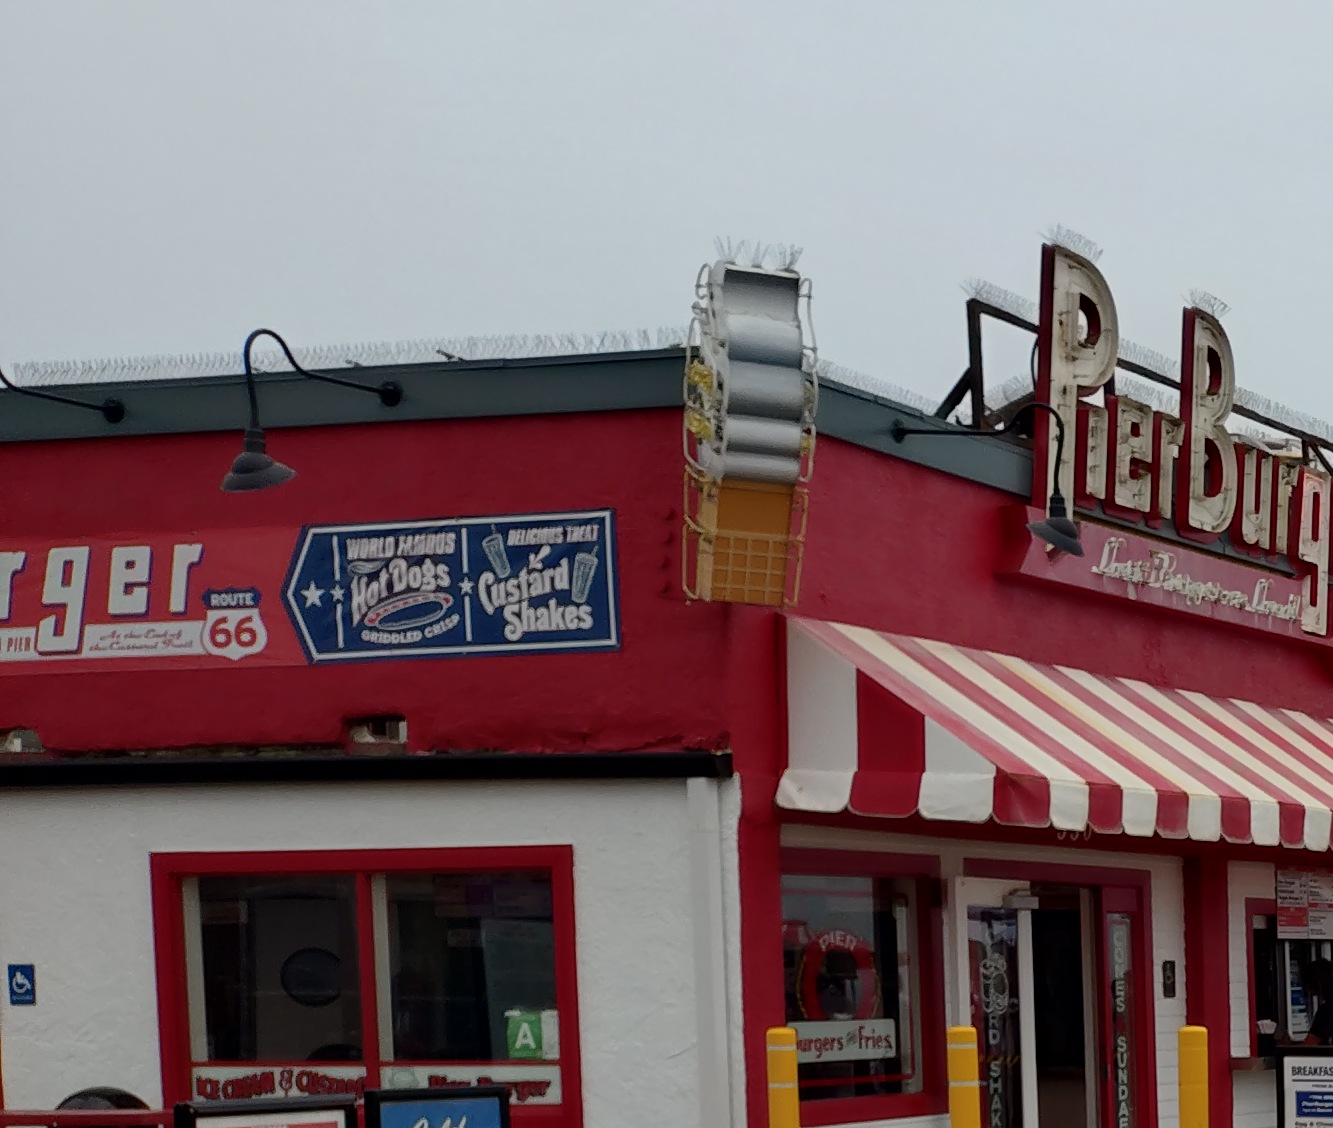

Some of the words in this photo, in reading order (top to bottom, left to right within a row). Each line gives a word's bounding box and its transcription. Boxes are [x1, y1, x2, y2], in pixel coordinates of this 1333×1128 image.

[345, 535, 395, 560] WORLD
[396, 531, 456, 557] FAMOUS
[507, 526, 564, 547] DELICIOUS
[566, 524, 600, 543] TREAT
[210, 592, 254, 606] ROUTE
[350, 566, 390, 628] Hot
[388, 557, 451, 593] Dogs
[478, 556, 570, 616] Custard
[209, 615, 257, 648] 66
[361, 629, 423, 645] GRIDDLED
[424, 613, 461, 639] CRISP
[502, 597, 594, 641] Shakes
[7, 636, 31, 653] PIER
[514, 1022, 537, 1049] A
[796, 1036, 844, 1059] urgers
[858, 1024, 892, 1050] Fries
